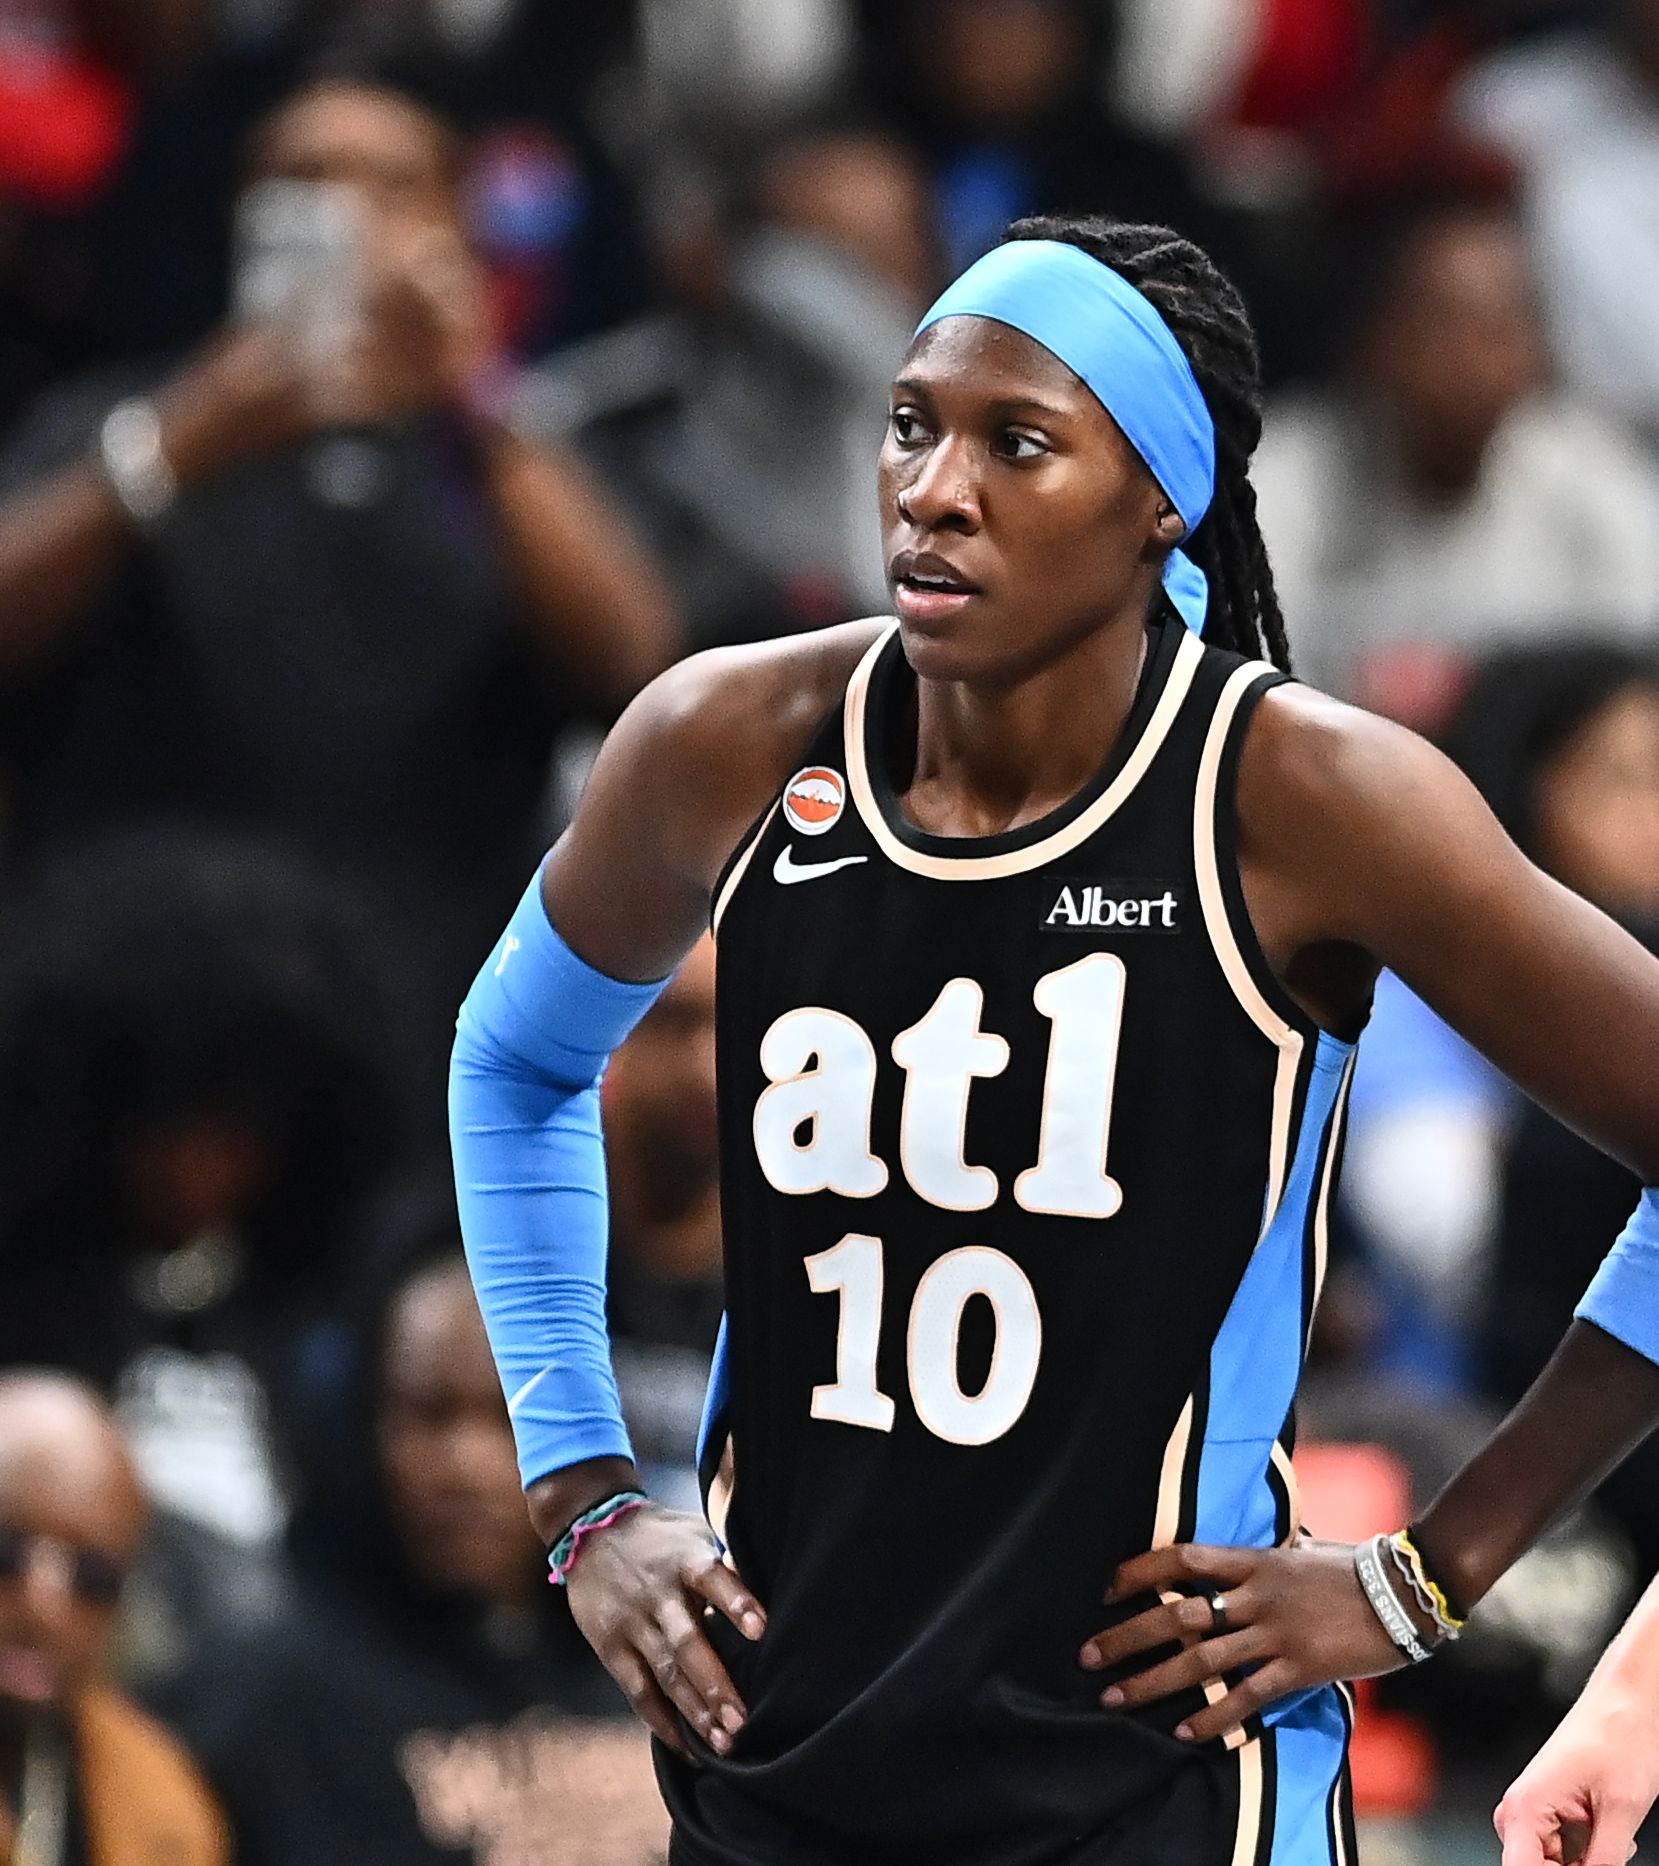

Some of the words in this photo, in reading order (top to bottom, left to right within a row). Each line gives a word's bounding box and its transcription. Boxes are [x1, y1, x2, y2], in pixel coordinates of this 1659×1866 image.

[1044, 885, 1178, 928] Albert
[803, 1232, 1043, 1447] 10
[1375, 1594, 1432, 1661] OSSIANS
